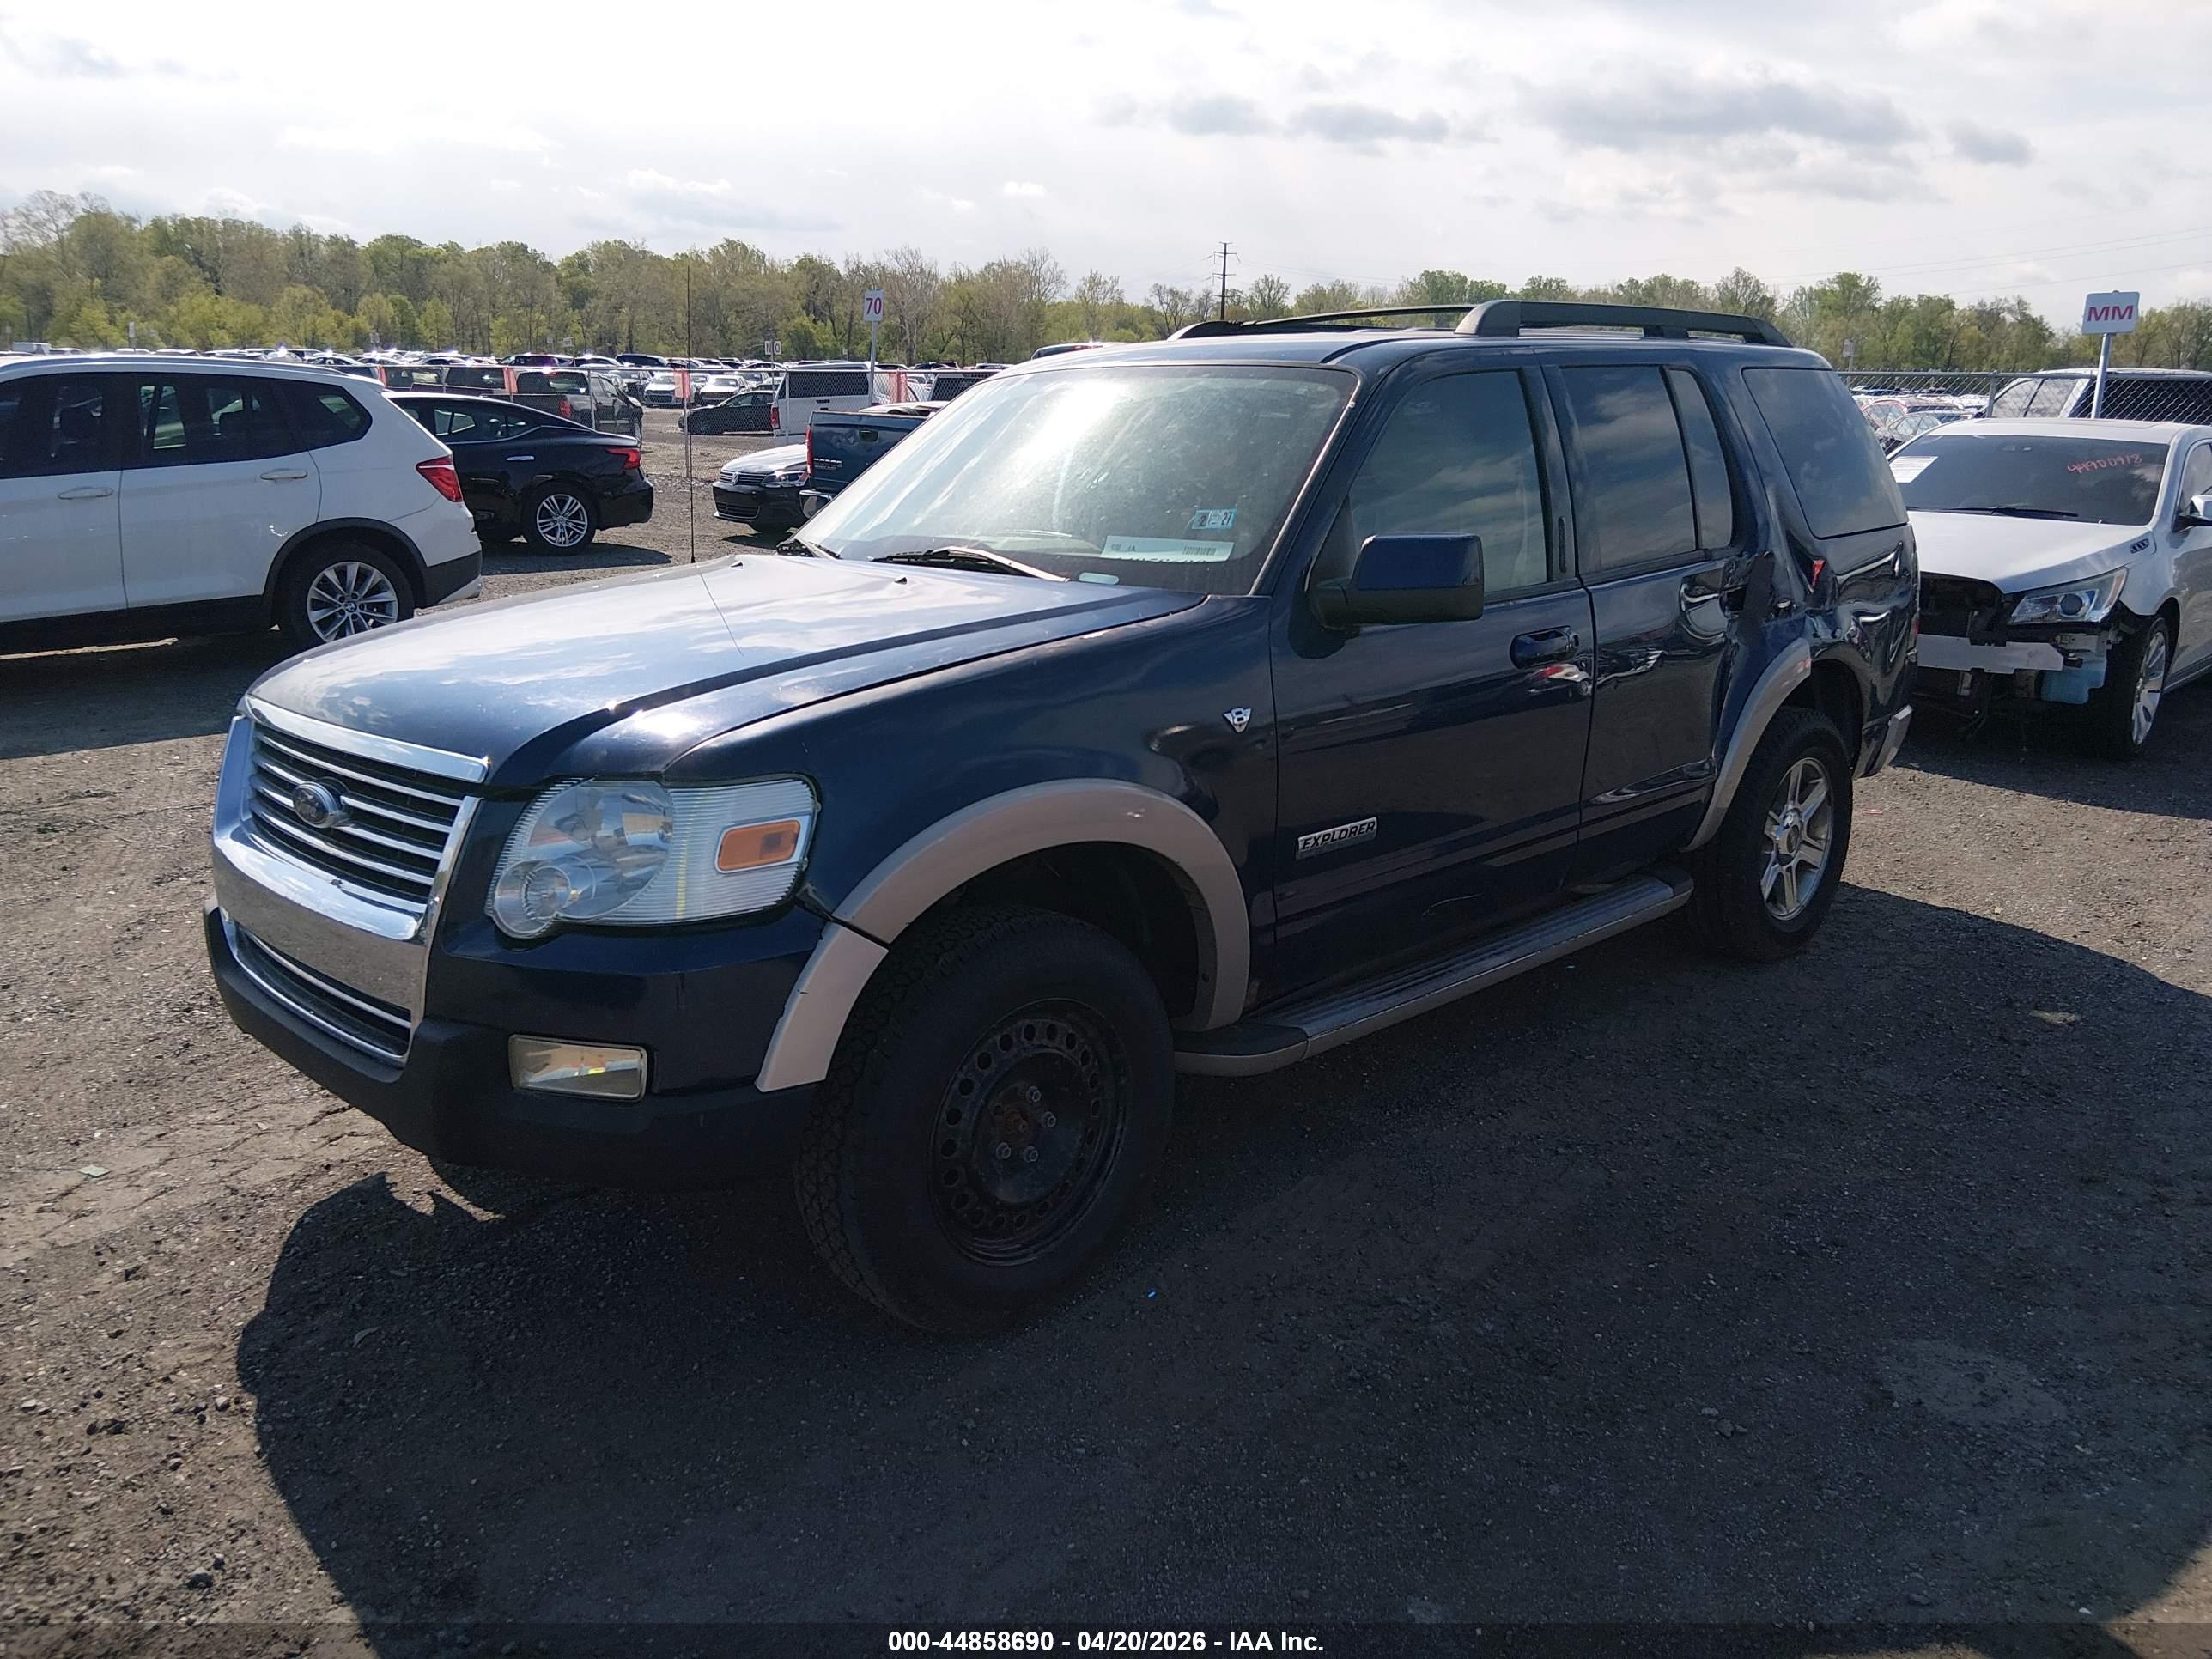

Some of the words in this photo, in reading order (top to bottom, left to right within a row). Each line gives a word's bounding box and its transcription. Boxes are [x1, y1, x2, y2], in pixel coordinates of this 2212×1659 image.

[866, 297, 882, 315] 70
[2087, 305, 2134, 322] MM
[1302, 820, 1376, 850] EXPLORER
